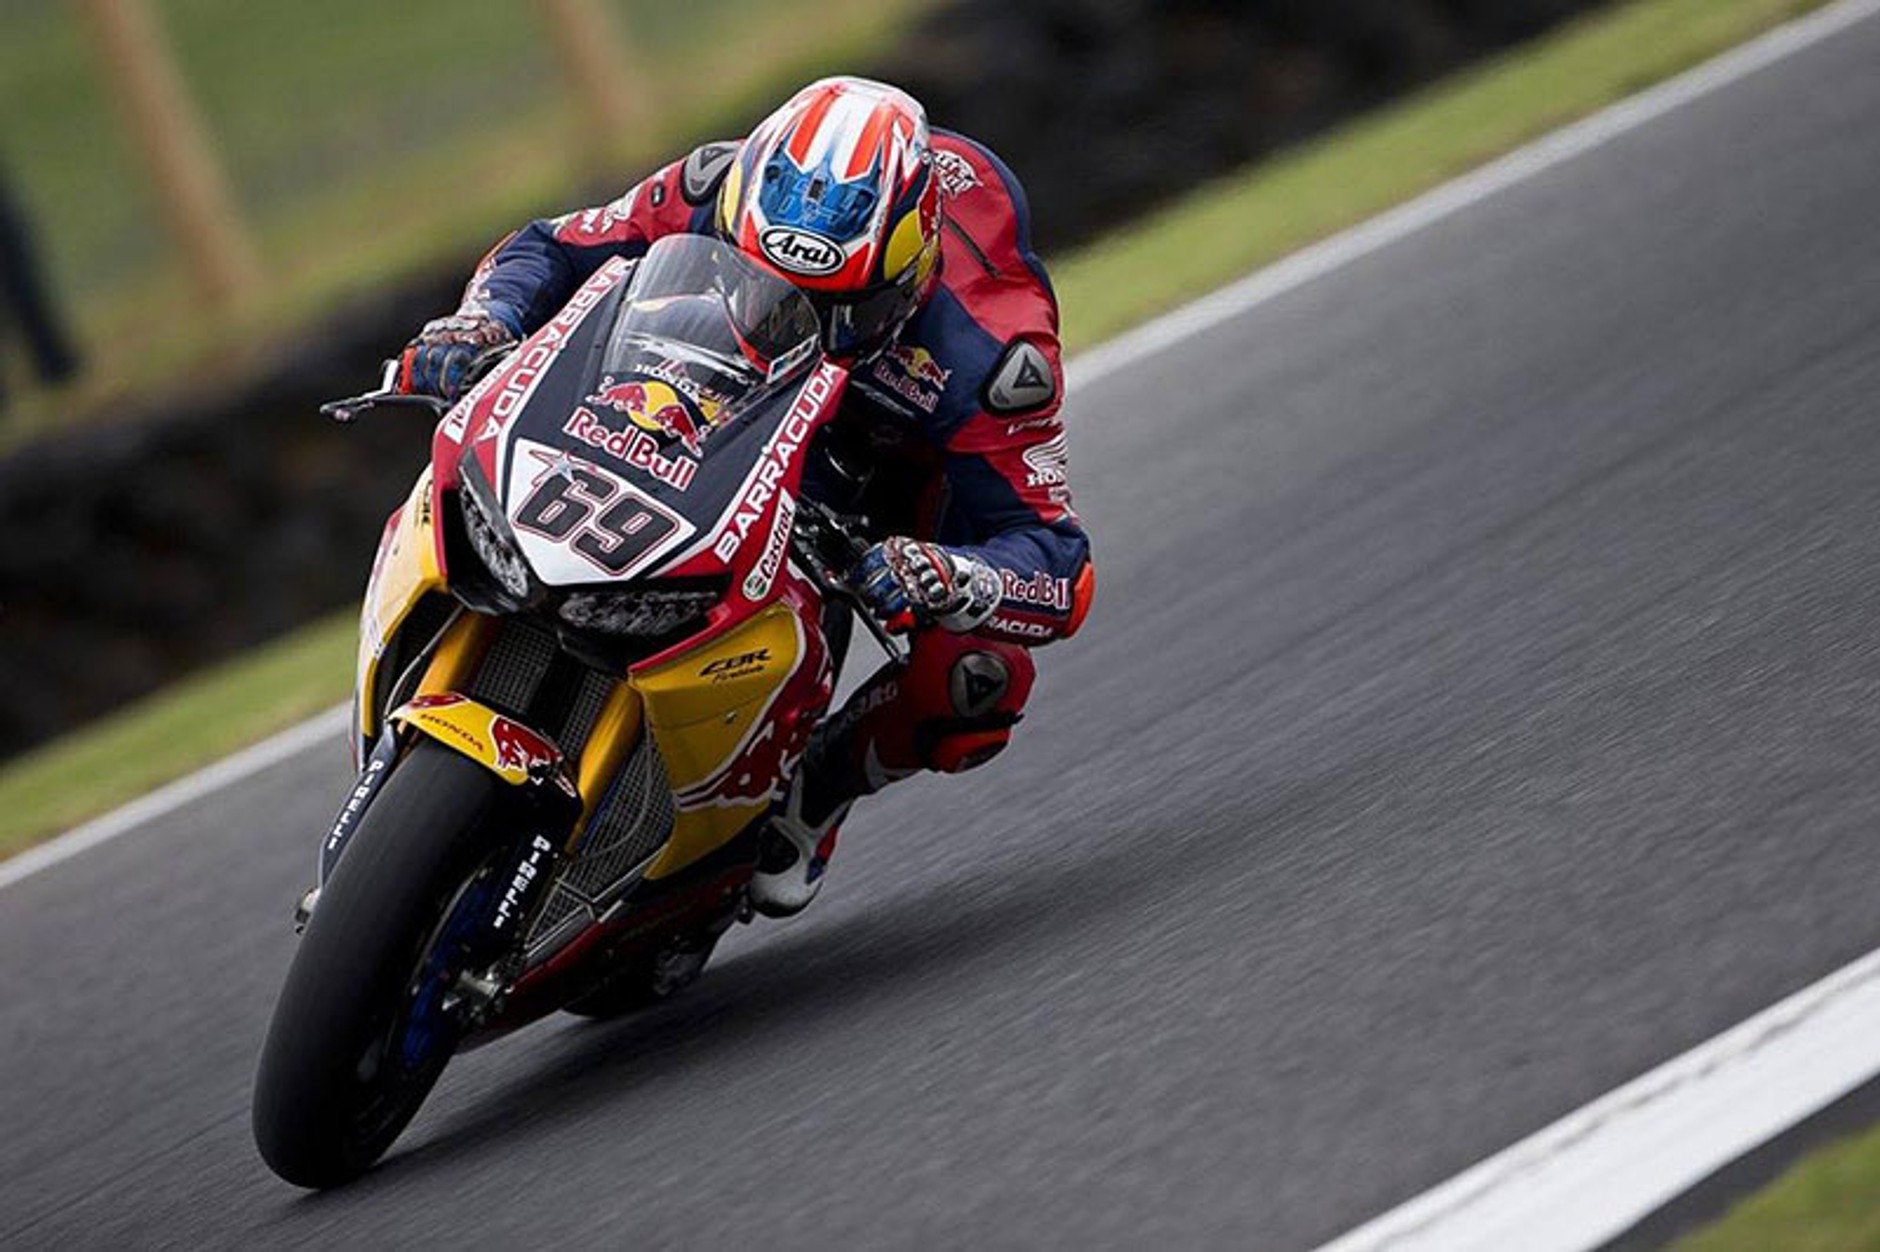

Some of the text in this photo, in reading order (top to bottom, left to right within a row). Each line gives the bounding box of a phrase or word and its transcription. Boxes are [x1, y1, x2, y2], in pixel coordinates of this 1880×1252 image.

[767, 234, 830, 264] Arai
[561, 406, 699, 492] Red Bull
[713, 361, 841, 564] BARRACUDA
[511, 462, 681, 576] 69
[759, 502, 792, 579] Castrol
[986, 614, 1054, 638] RACUDA
[999, 568, 1071, 610] Red Bll
[421, 712, 484, 752] HONDA
[328, 759, 385, 850] PIRELLI
[493, 834, 551, 929] PIRELLI
